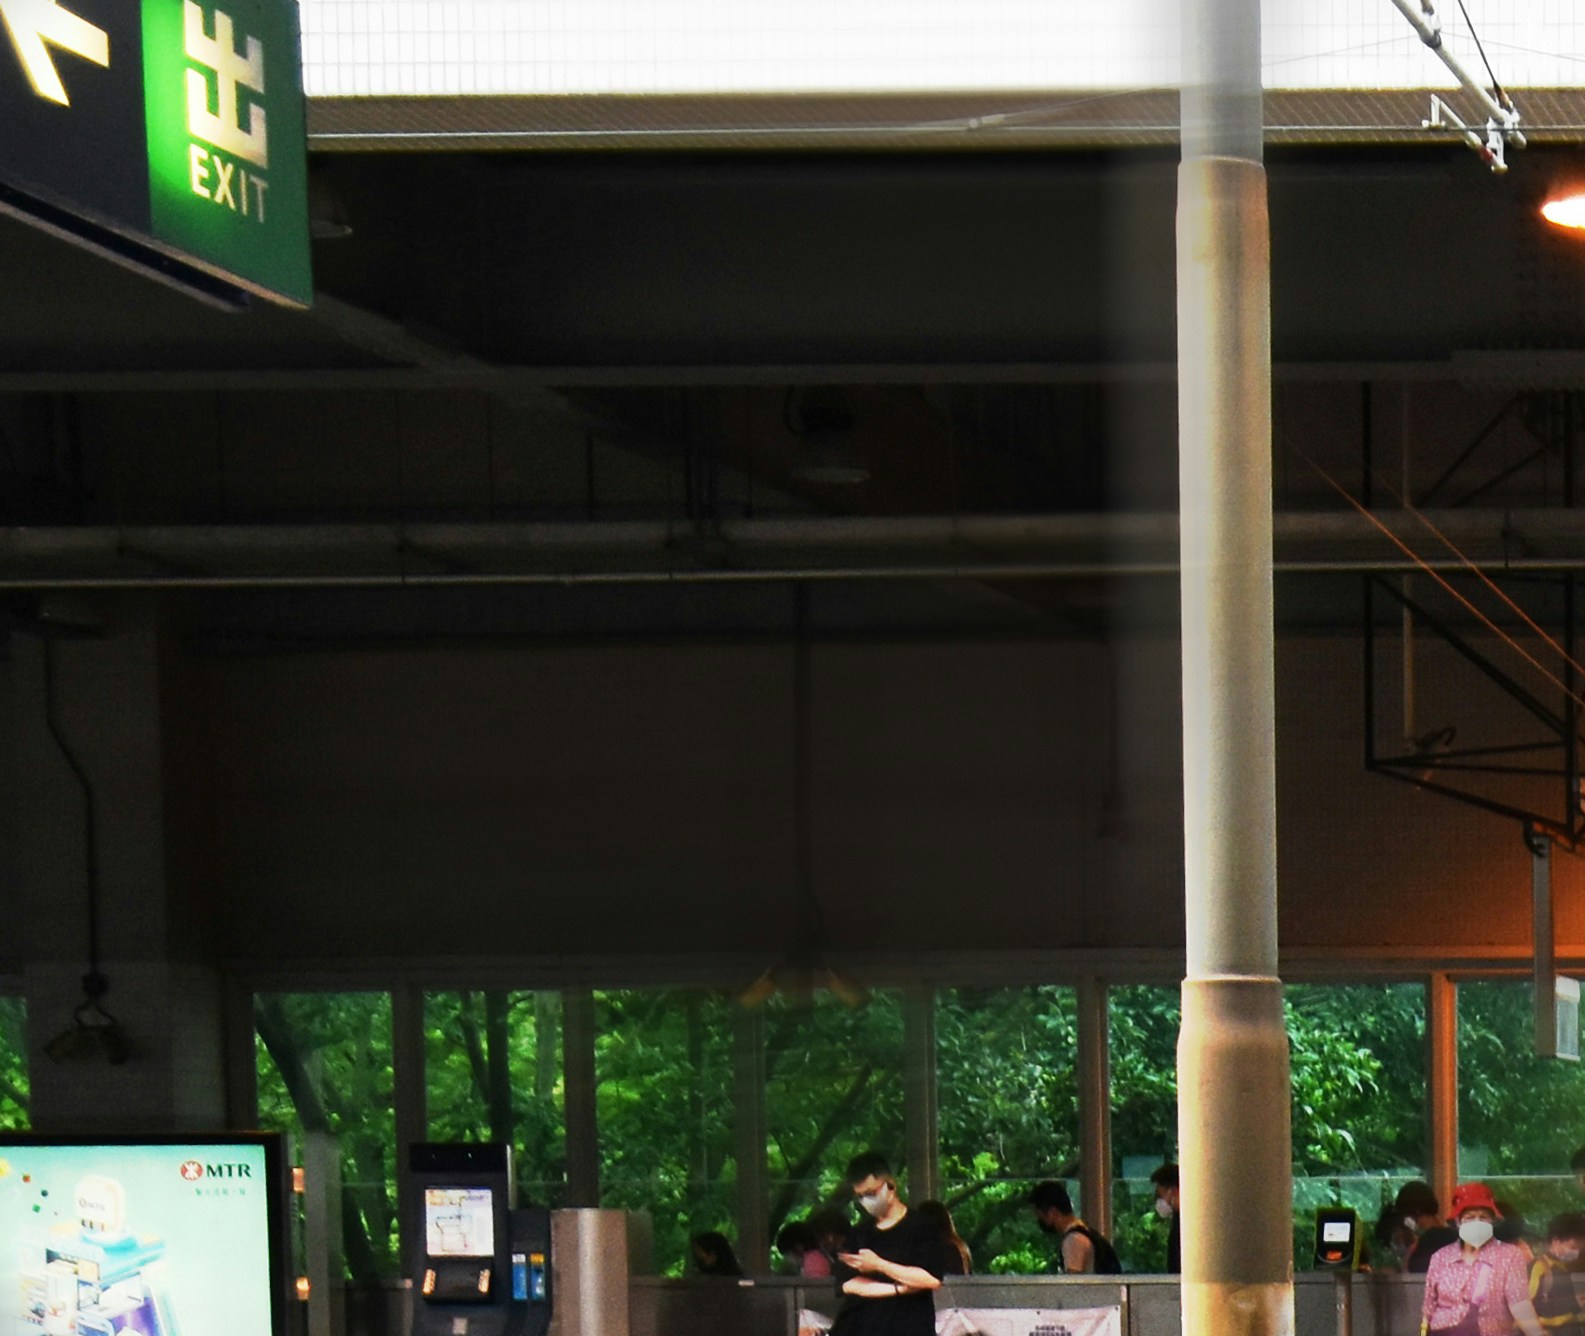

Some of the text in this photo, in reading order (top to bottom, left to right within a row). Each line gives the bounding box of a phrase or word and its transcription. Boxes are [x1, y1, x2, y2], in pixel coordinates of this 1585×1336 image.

[184, 0, 269, 170] 出
[189, 142, 269, 224] EXIT
[206, 1163, 252, 1178] MTR
